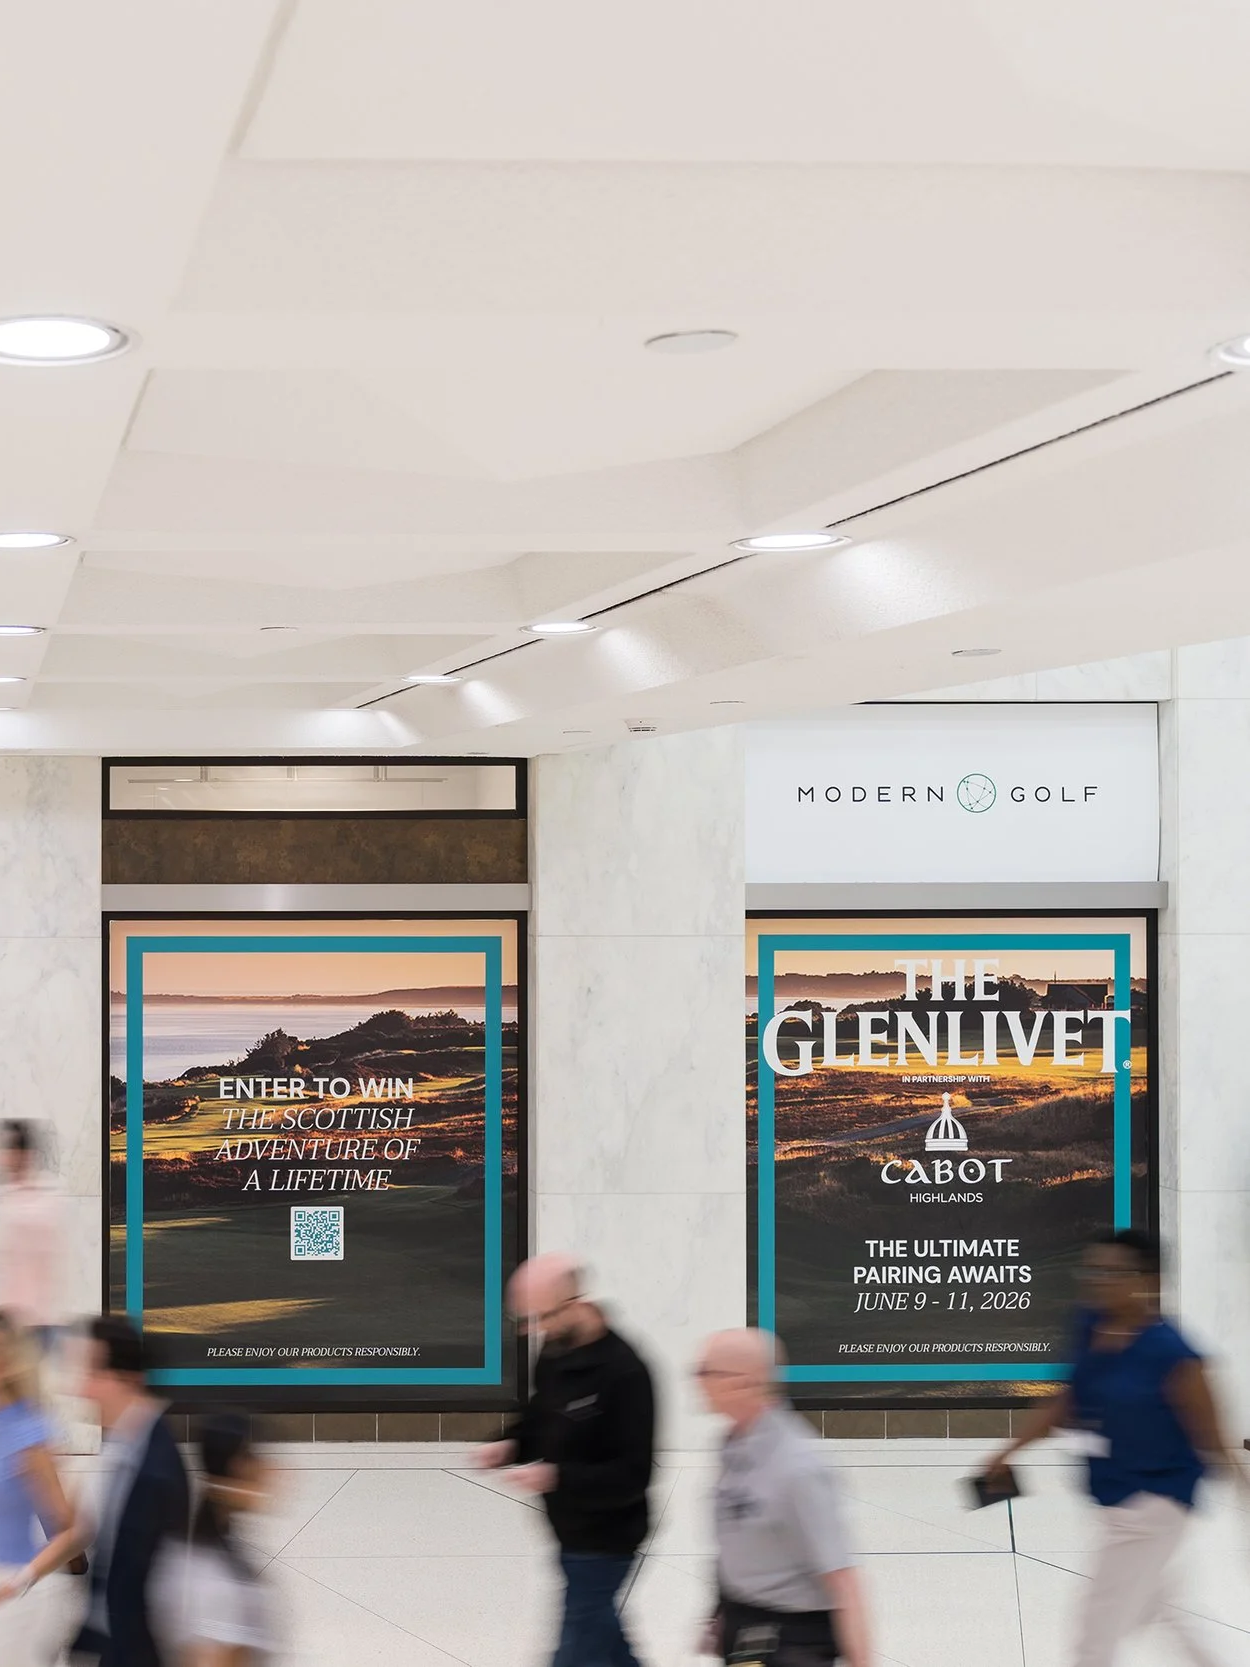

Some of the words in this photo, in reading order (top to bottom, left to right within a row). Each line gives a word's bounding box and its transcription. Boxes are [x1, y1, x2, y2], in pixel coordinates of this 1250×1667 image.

[798, 786, 944, 803] MODERN
[1010, 786, 1098, 803] GOLF
[894, 958, 1000, 1001] THE
[219, 1077, 305, 1099] ENTER
[313, 1077, 351, 1099] TO
[358, 1077, 414, 1099] WIN
[902, 1075, 910, 1083] IN
[912, 1075, 966, 1083] PARTNERSHIP
[967, 1075, 990, 1083] WITH
[222, 1108, 276, 1130] THE
[280, 1107, 415, 1130] SCOTTISH
[214, 1138, 378, 1160] ADVENTURE
[384, 1138, 421, 1160] OF
[241, 1169, 262, 1191] A
[268, 1169, 392, 1191] LIFETIME
[880, 1158, 1013, 1184] CABOT
[910, 1192, 984, 1203] HIGHLANDS
[865, 1239, 908, 1257] THE
[914, 1239, 1020, 1257] ULTIMATE
[853, 1265, 941, 1284] PAIRING
[947, 1265, 1032, 1284] AWAITS
[854, 1292, 910, 1313] JUNE
[913, 1292, 927, 1311] 9
[946, 1292, 975, 1313] 11,
[980, 1291, 1032, 1310] 2026
[207, 1347, 243, 1357] PLEASE
[245, 1347, 276, 1358] ENJOY
[277, 1347, 299, 1357] OUR
[301, 1347, 353, 1357] PRODUCTS
[354, 1347, 421, 1357] RESPONSIBLY.
[838, 1344, 875, 1353] PLEASE
[876, 1344, 907, 1354] ENJOY
[908, 1343, 930, 1353] OUR
[931, 1343, 983, 1352] PRODUCTS
[985, 1342, 1051, 1352] RESPONSIBLY.
